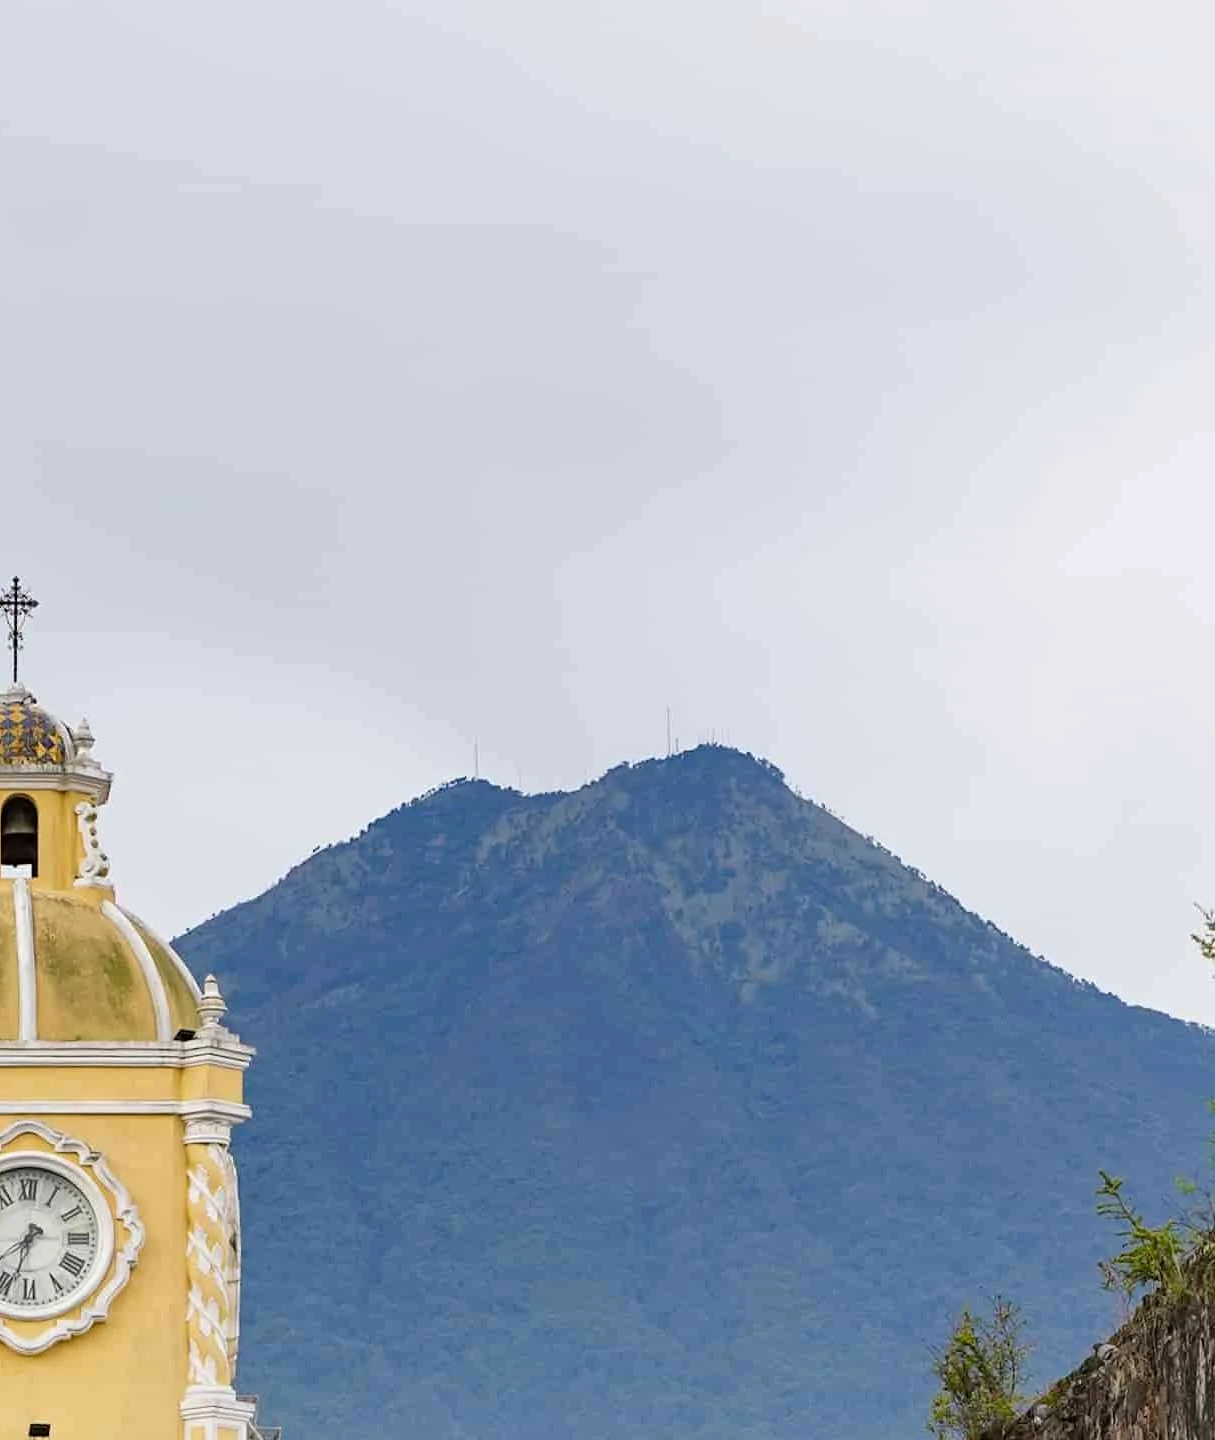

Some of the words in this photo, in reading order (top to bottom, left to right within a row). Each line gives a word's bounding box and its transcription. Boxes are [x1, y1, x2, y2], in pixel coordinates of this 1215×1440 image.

[19, 1179, 38, 1201] XII
[45, 1186, 60, 1208] I
[61, 1205, 83, 1222] II
[67, 1232, 90, 1246] III
[58, 1251, 86, 1277] IIII
[23, 1278, 36, 1300] VI
[49, 1272, 63, 1293] V
